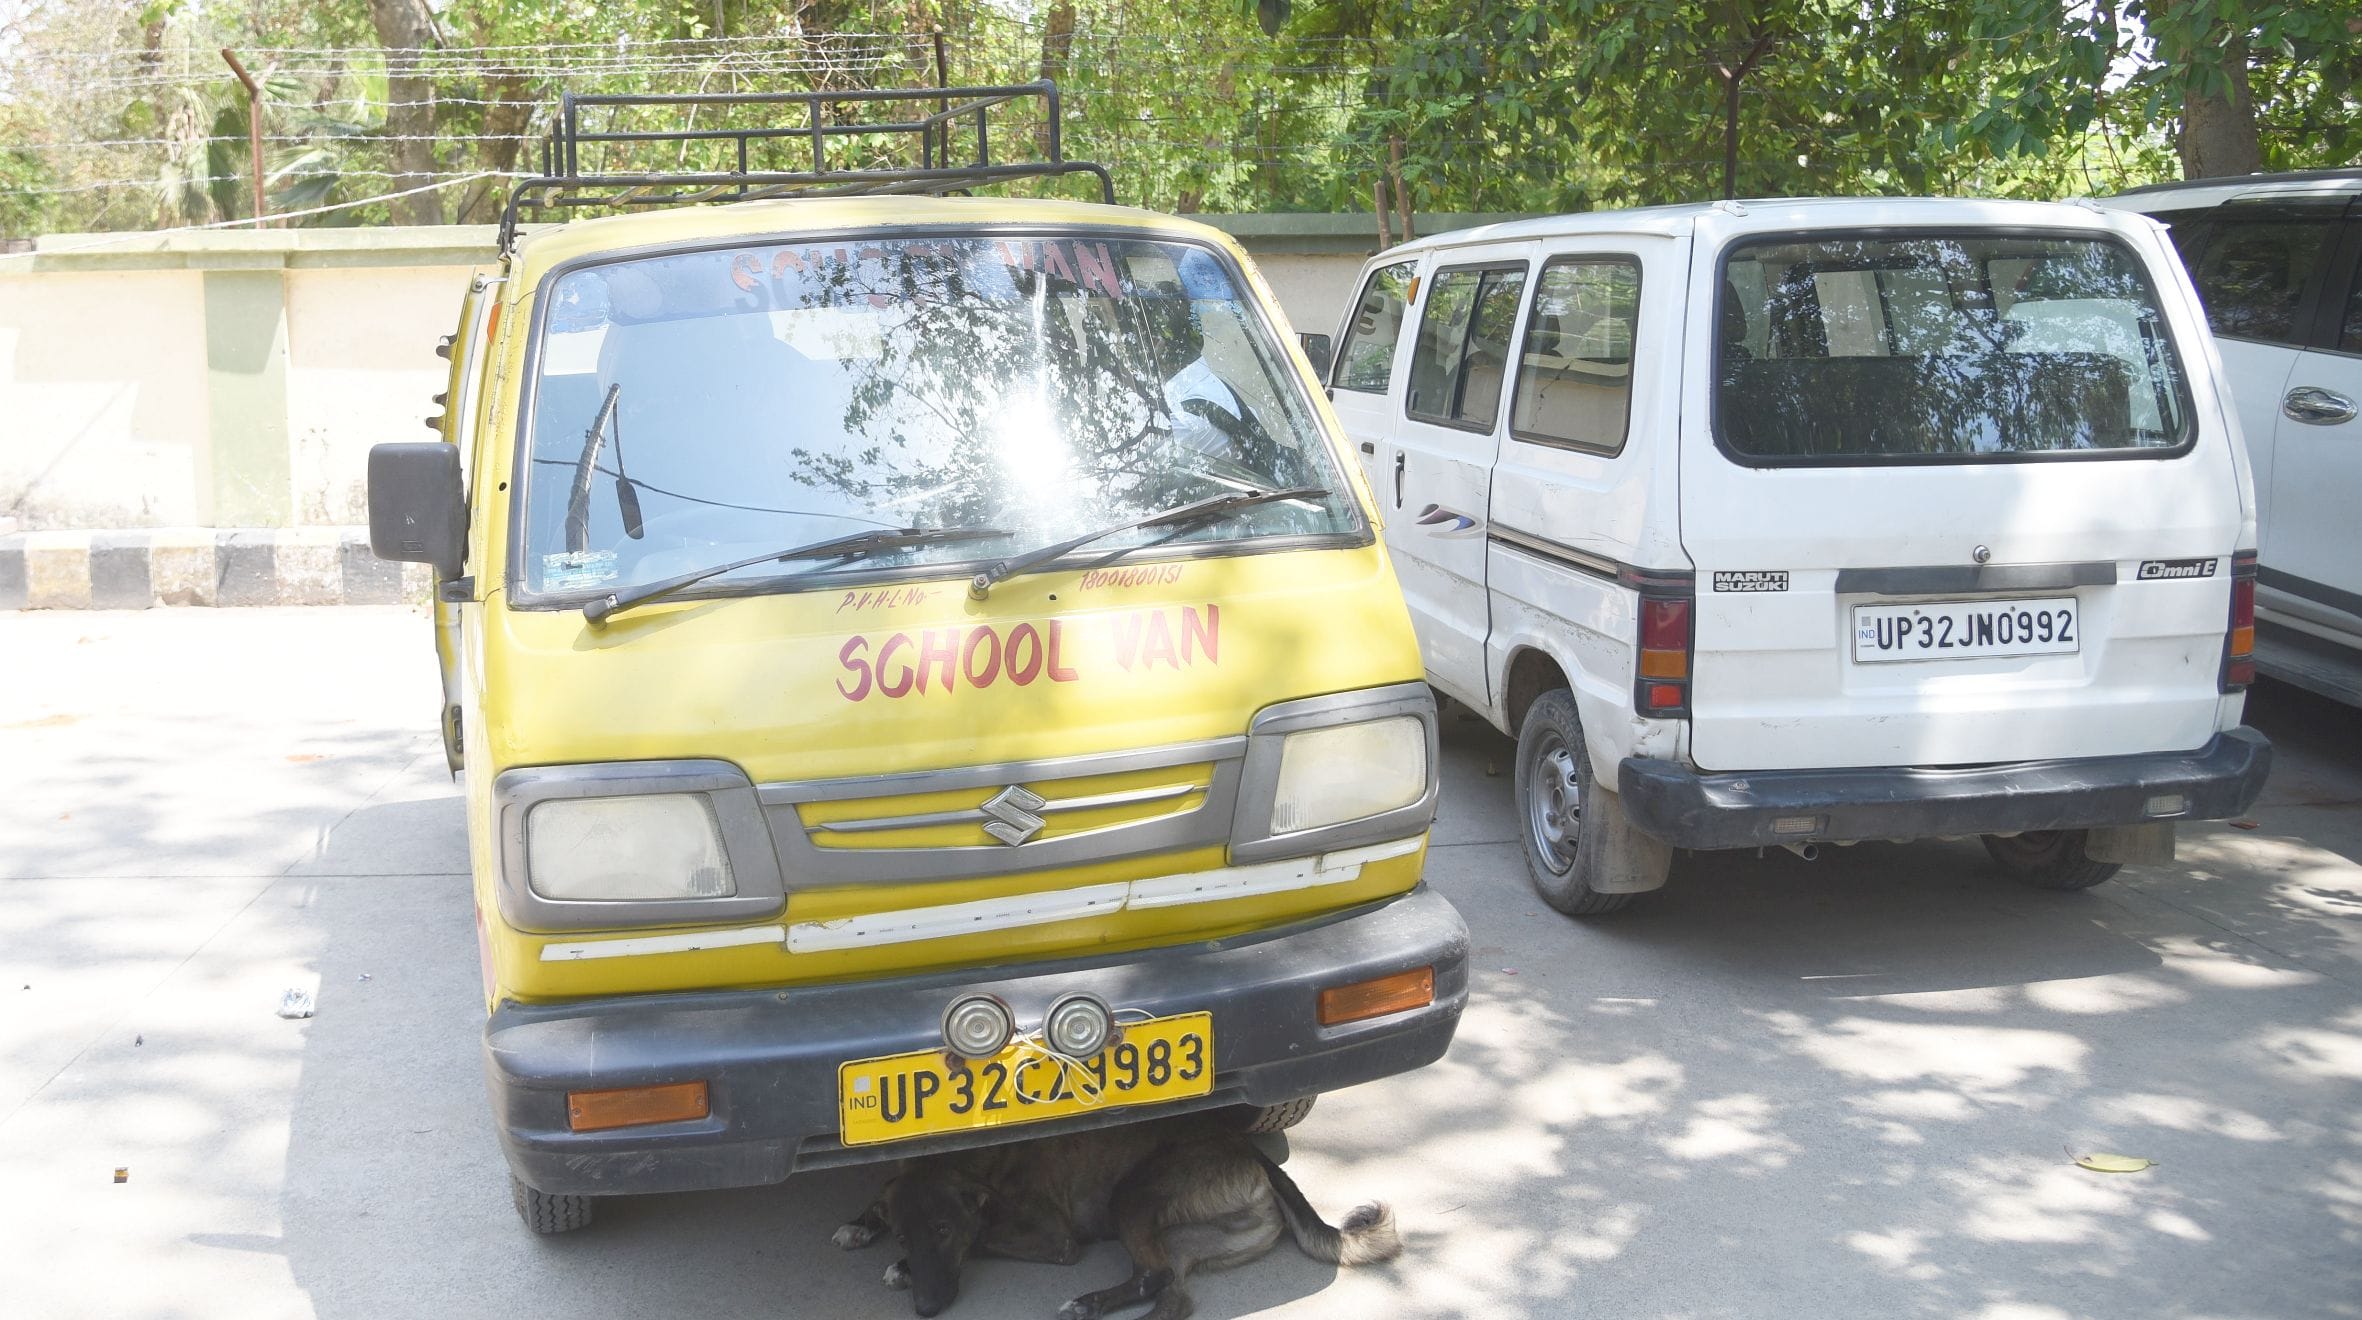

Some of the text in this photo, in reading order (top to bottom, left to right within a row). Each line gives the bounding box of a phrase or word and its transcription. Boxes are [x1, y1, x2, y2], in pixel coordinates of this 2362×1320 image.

[1715, 572, 1788, 582] MARUTI
[1715, 581, 1788, 592] SUZUKI
[1858, 610, 2074, 650] IND UP32JN0992
[836, 603, 1219, 702] SCHOOL VAN
[850, 1095, 877, 1110] IND
